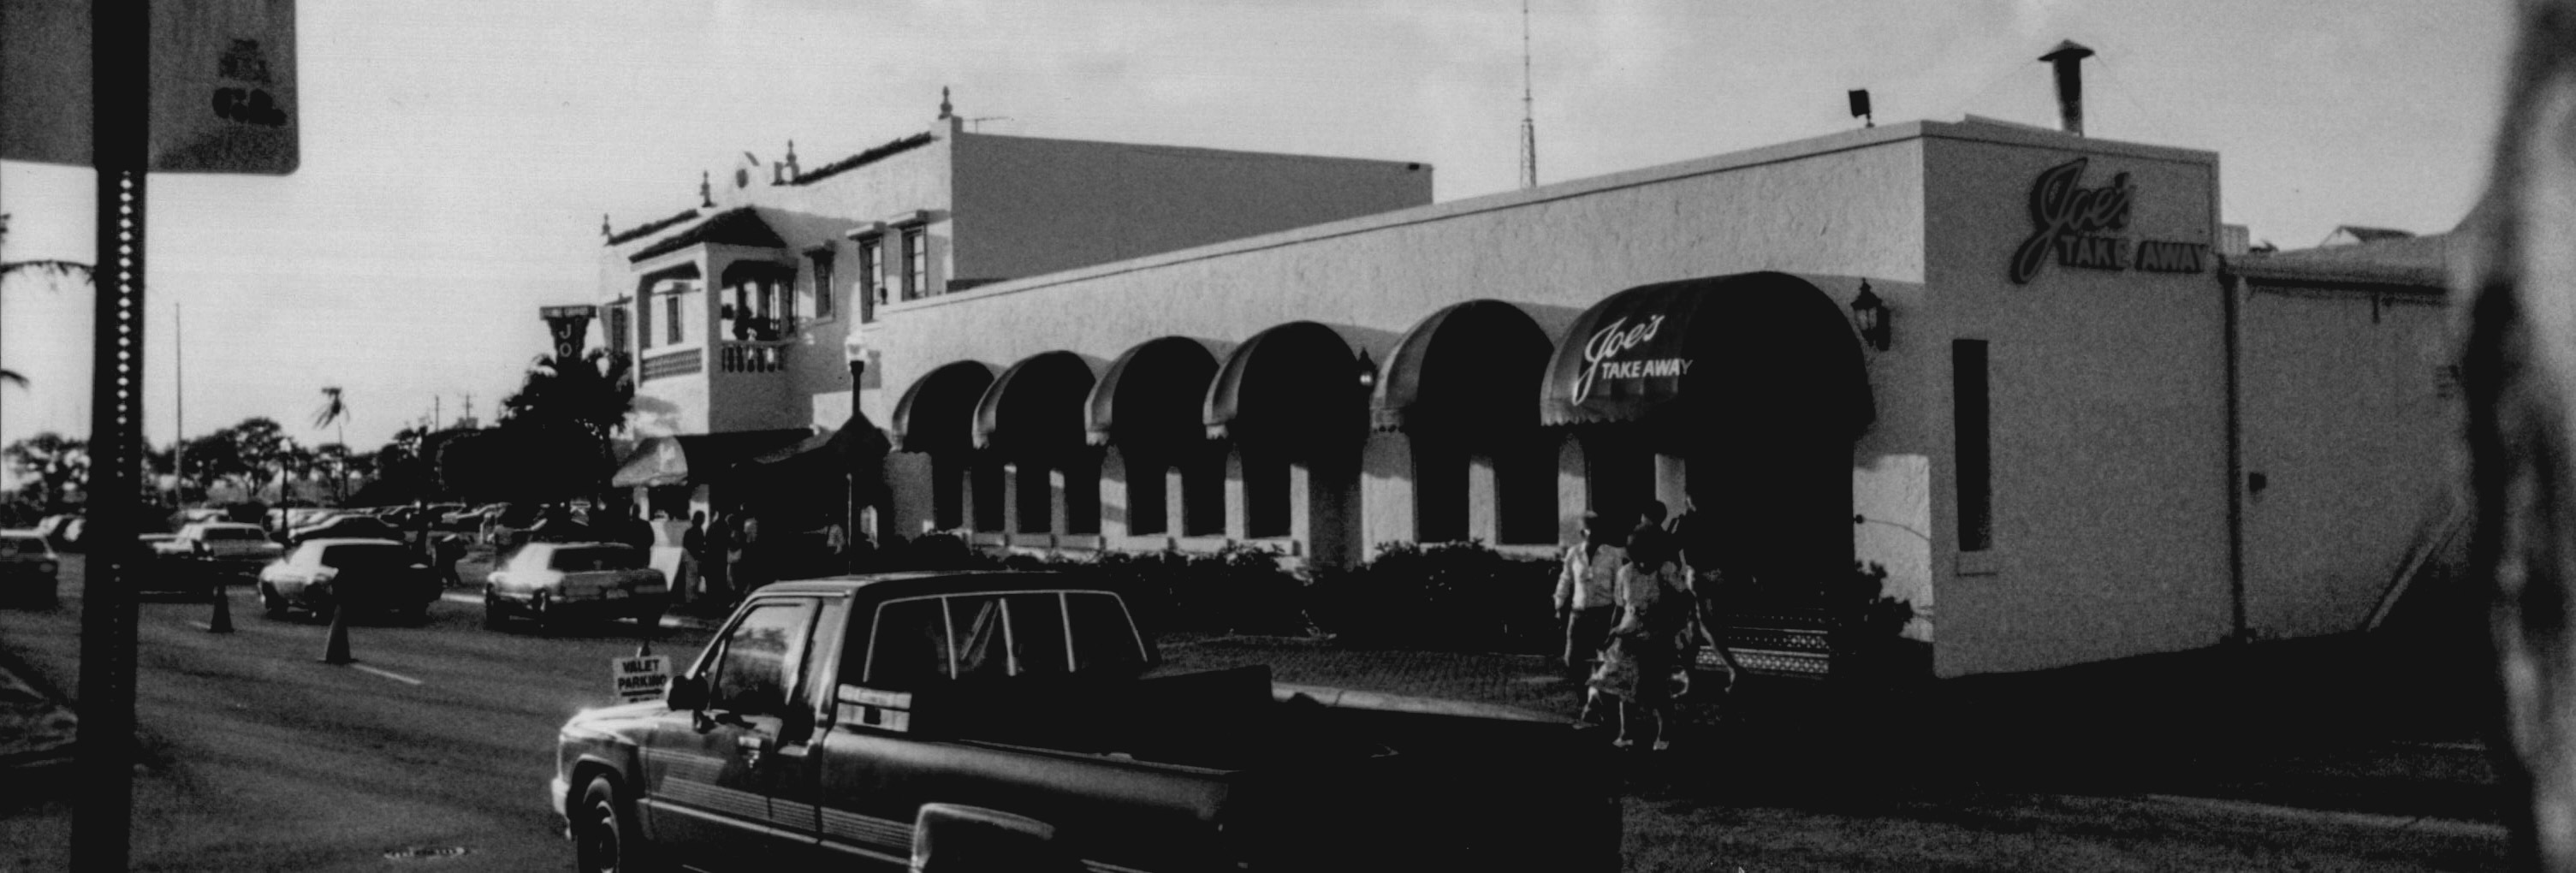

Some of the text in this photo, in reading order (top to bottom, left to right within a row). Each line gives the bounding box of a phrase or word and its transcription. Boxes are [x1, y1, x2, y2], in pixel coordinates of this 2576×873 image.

[2013, 157, 2137, 284] Joe's
[2060, 234, 2208, 273] TAKE AWAY
[1571, 314, 1666, 407] Joe's
[1601, 358, 1694, 380] TAKE AWAY
[622, 658, 660, 673] VALET
[617, 674, 667, 690] PARKING
